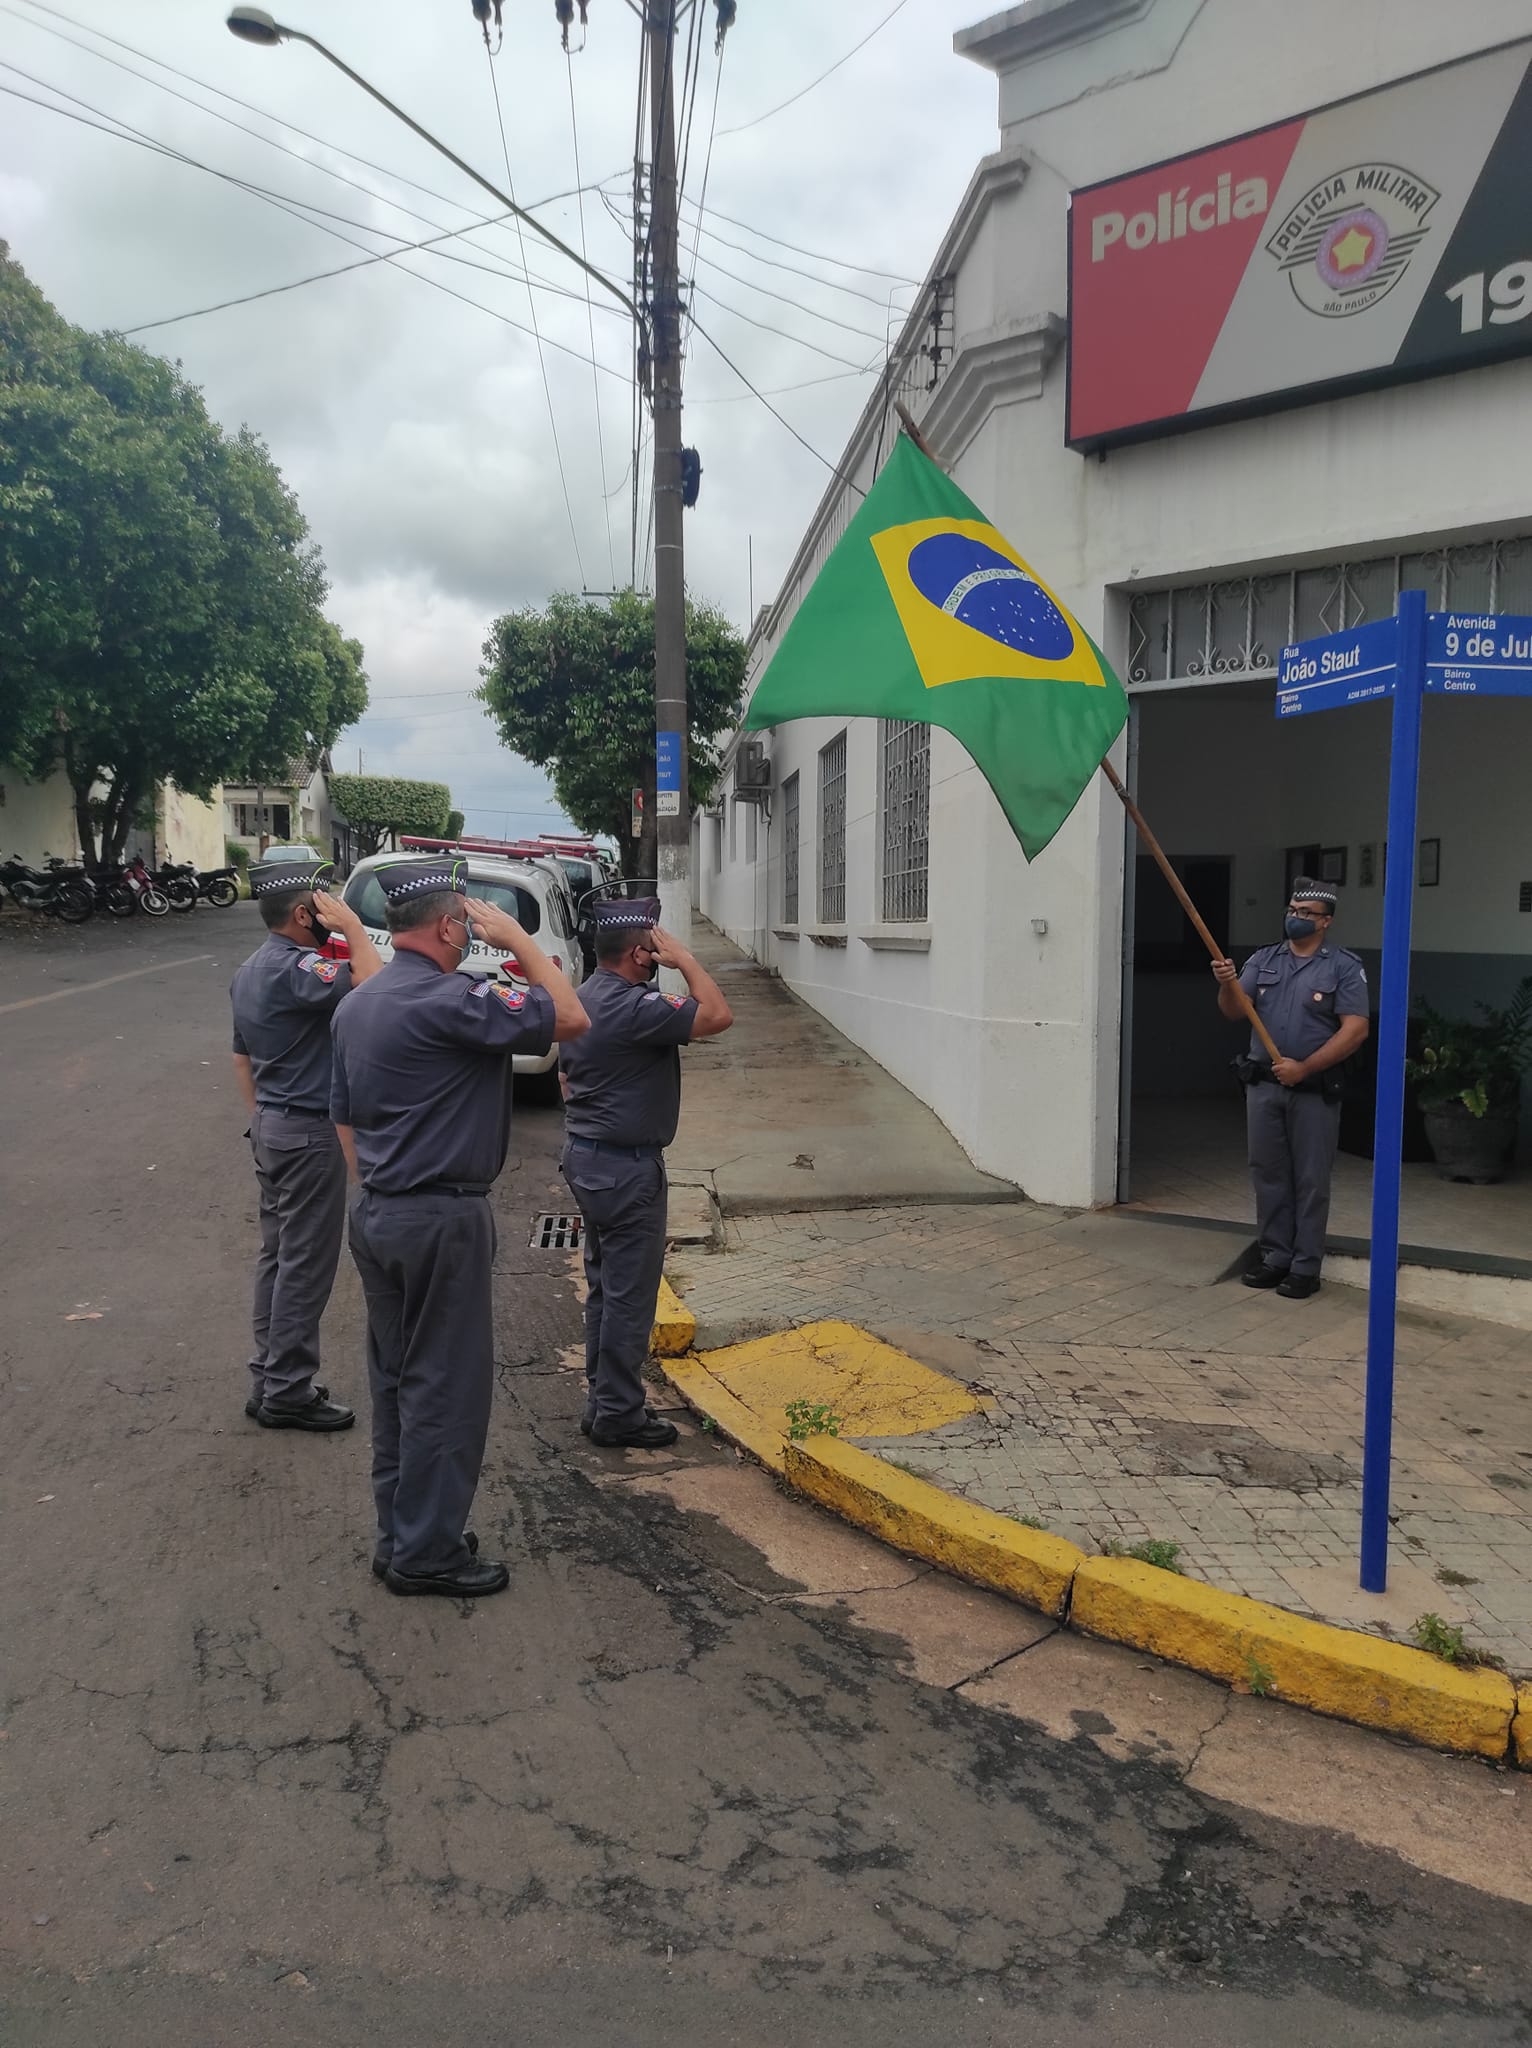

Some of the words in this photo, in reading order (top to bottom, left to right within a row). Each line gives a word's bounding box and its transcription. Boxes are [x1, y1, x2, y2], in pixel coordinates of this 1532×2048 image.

[1355, 170, 1428, 213] MILITAR
[1091, 172, 1268, 263] Polícia
[1323, 302, 1342, 312] SÃO
[1345, 291, 1376, 311] PAULO
[1447, 615, 1496, 630] Avenida
[1445, 632, 1459, 656] 9
[1466, 632, 1495, 657] de
[1283, 647, 1299, 660] Rua
[1282, 656, 1317, 684] João
[1321, 644, 1360, 674] Staut
[1444, 669, 1471, 679] Bairro
[1444, 680, 1476, 691] Centro
[1281, 694, 1299, 704] Bairro
[1281, 703, 1302, 714] Centro
